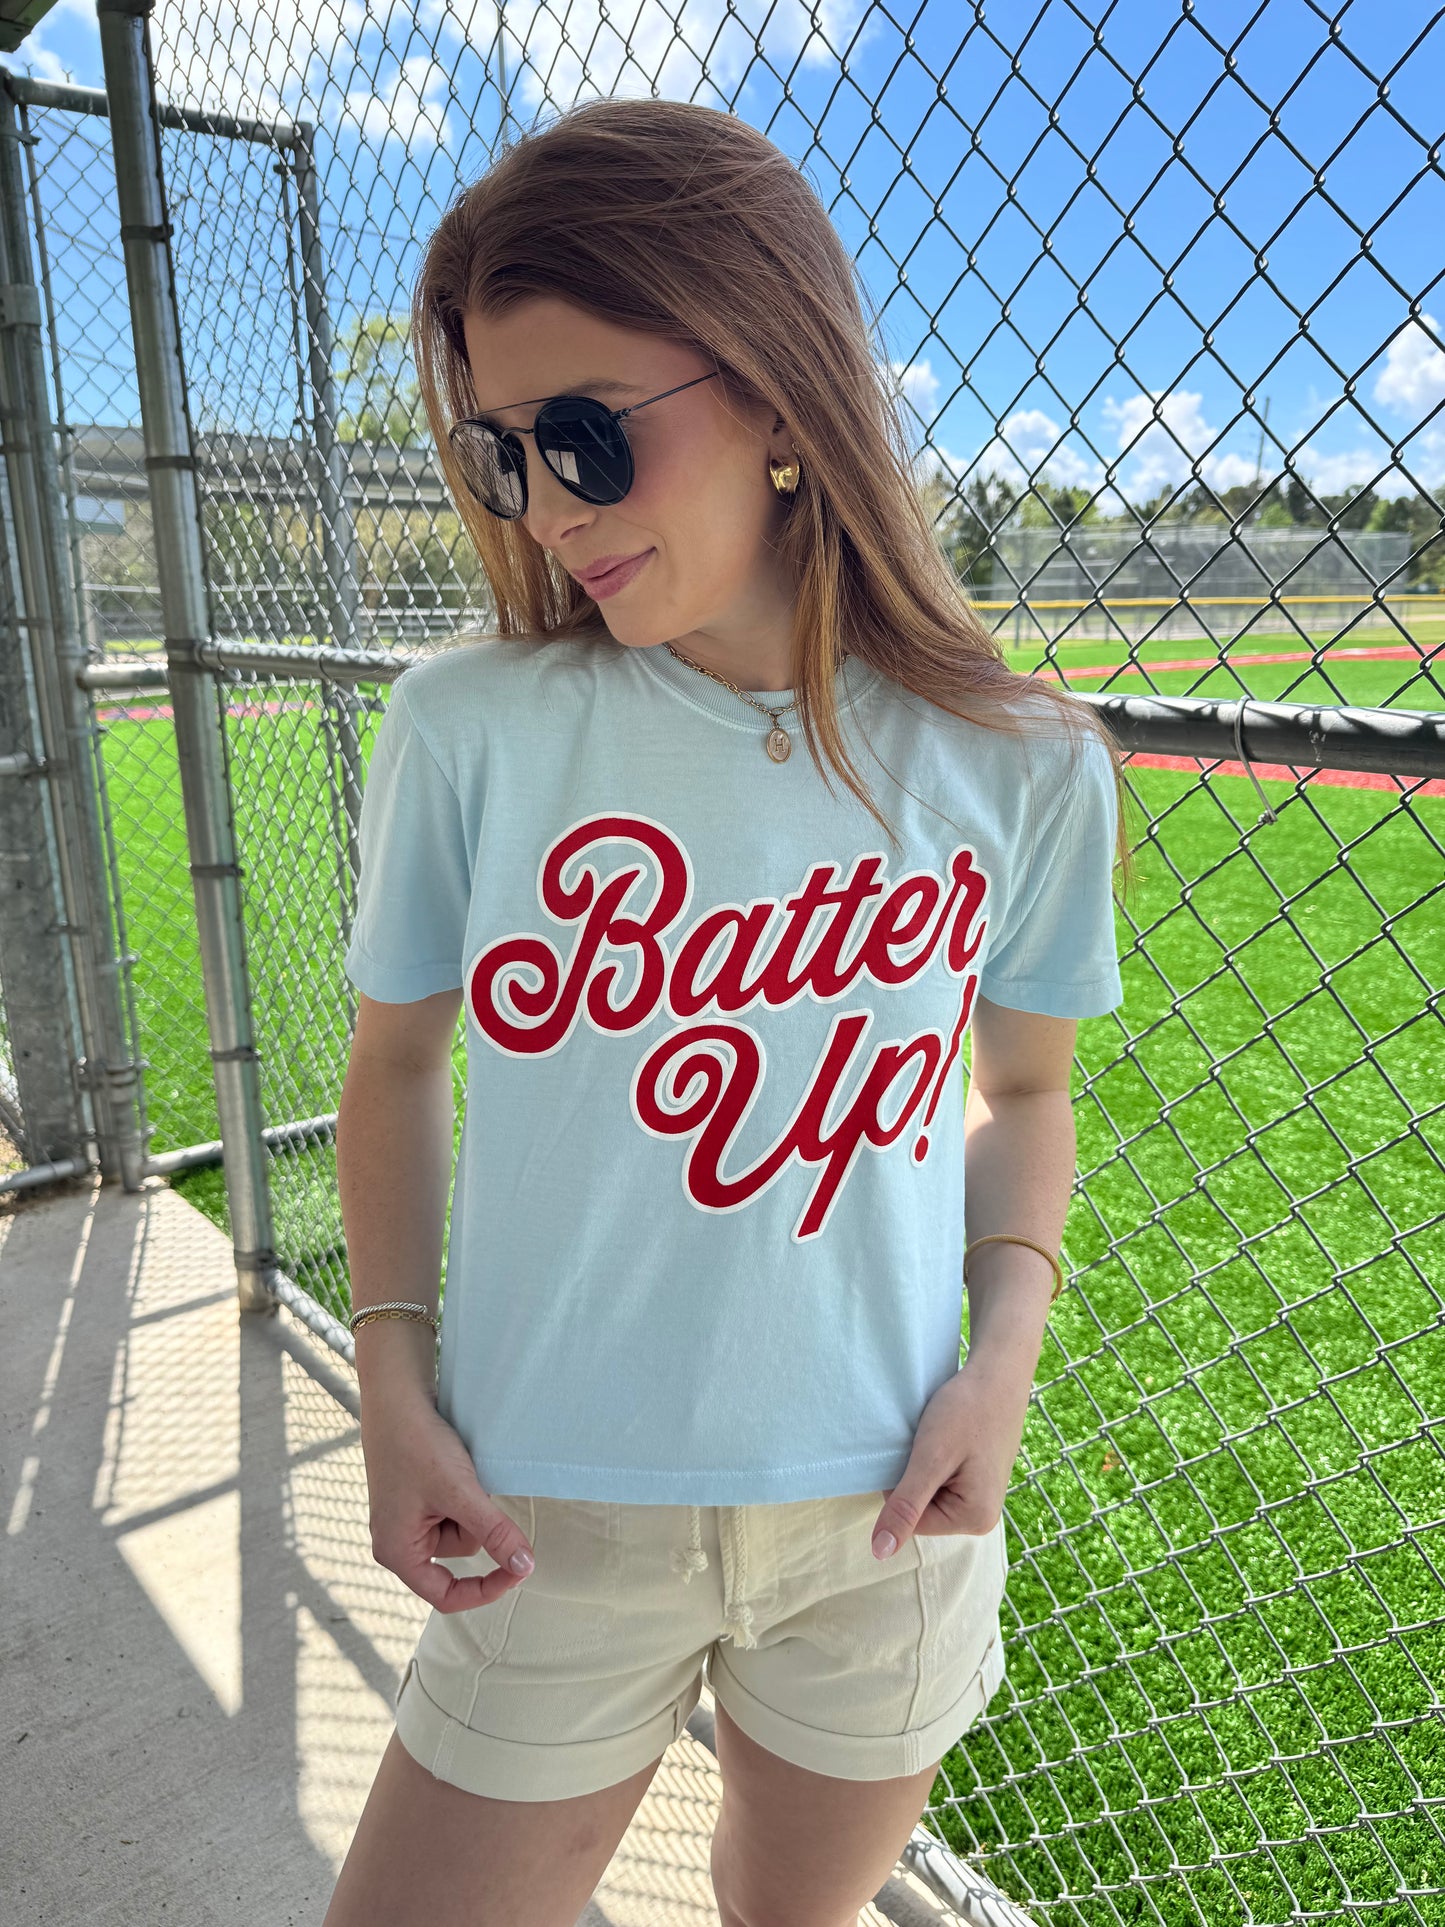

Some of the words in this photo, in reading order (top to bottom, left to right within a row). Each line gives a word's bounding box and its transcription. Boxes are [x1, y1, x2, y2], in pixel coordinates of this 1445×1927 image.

[774, 737, 786, 753] H
[470, 816, 989, 1054] Batter
[635, 973, 979, 1239] Up!
